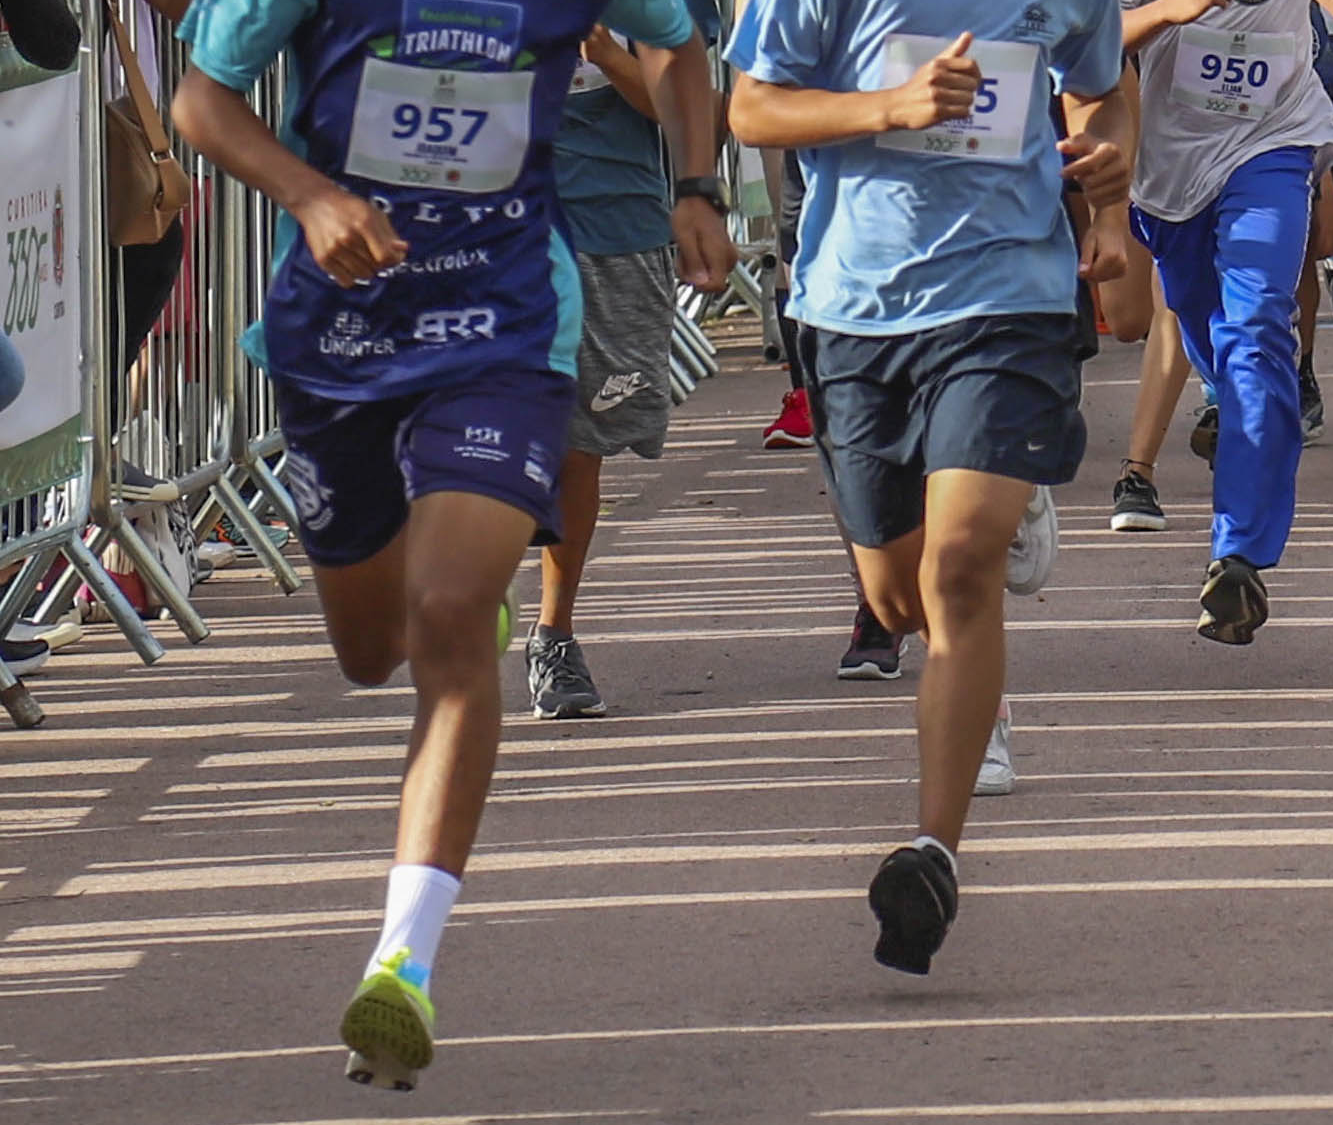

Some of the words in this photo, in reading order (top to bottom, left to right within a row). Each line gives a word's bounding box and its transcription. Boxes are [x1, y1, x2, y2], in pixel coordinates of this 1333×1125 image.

[404, 28, 512, 63] TRIATHLON
[1200, 53, 1269, 88] 950
[391, 102, 489, 147] 957
